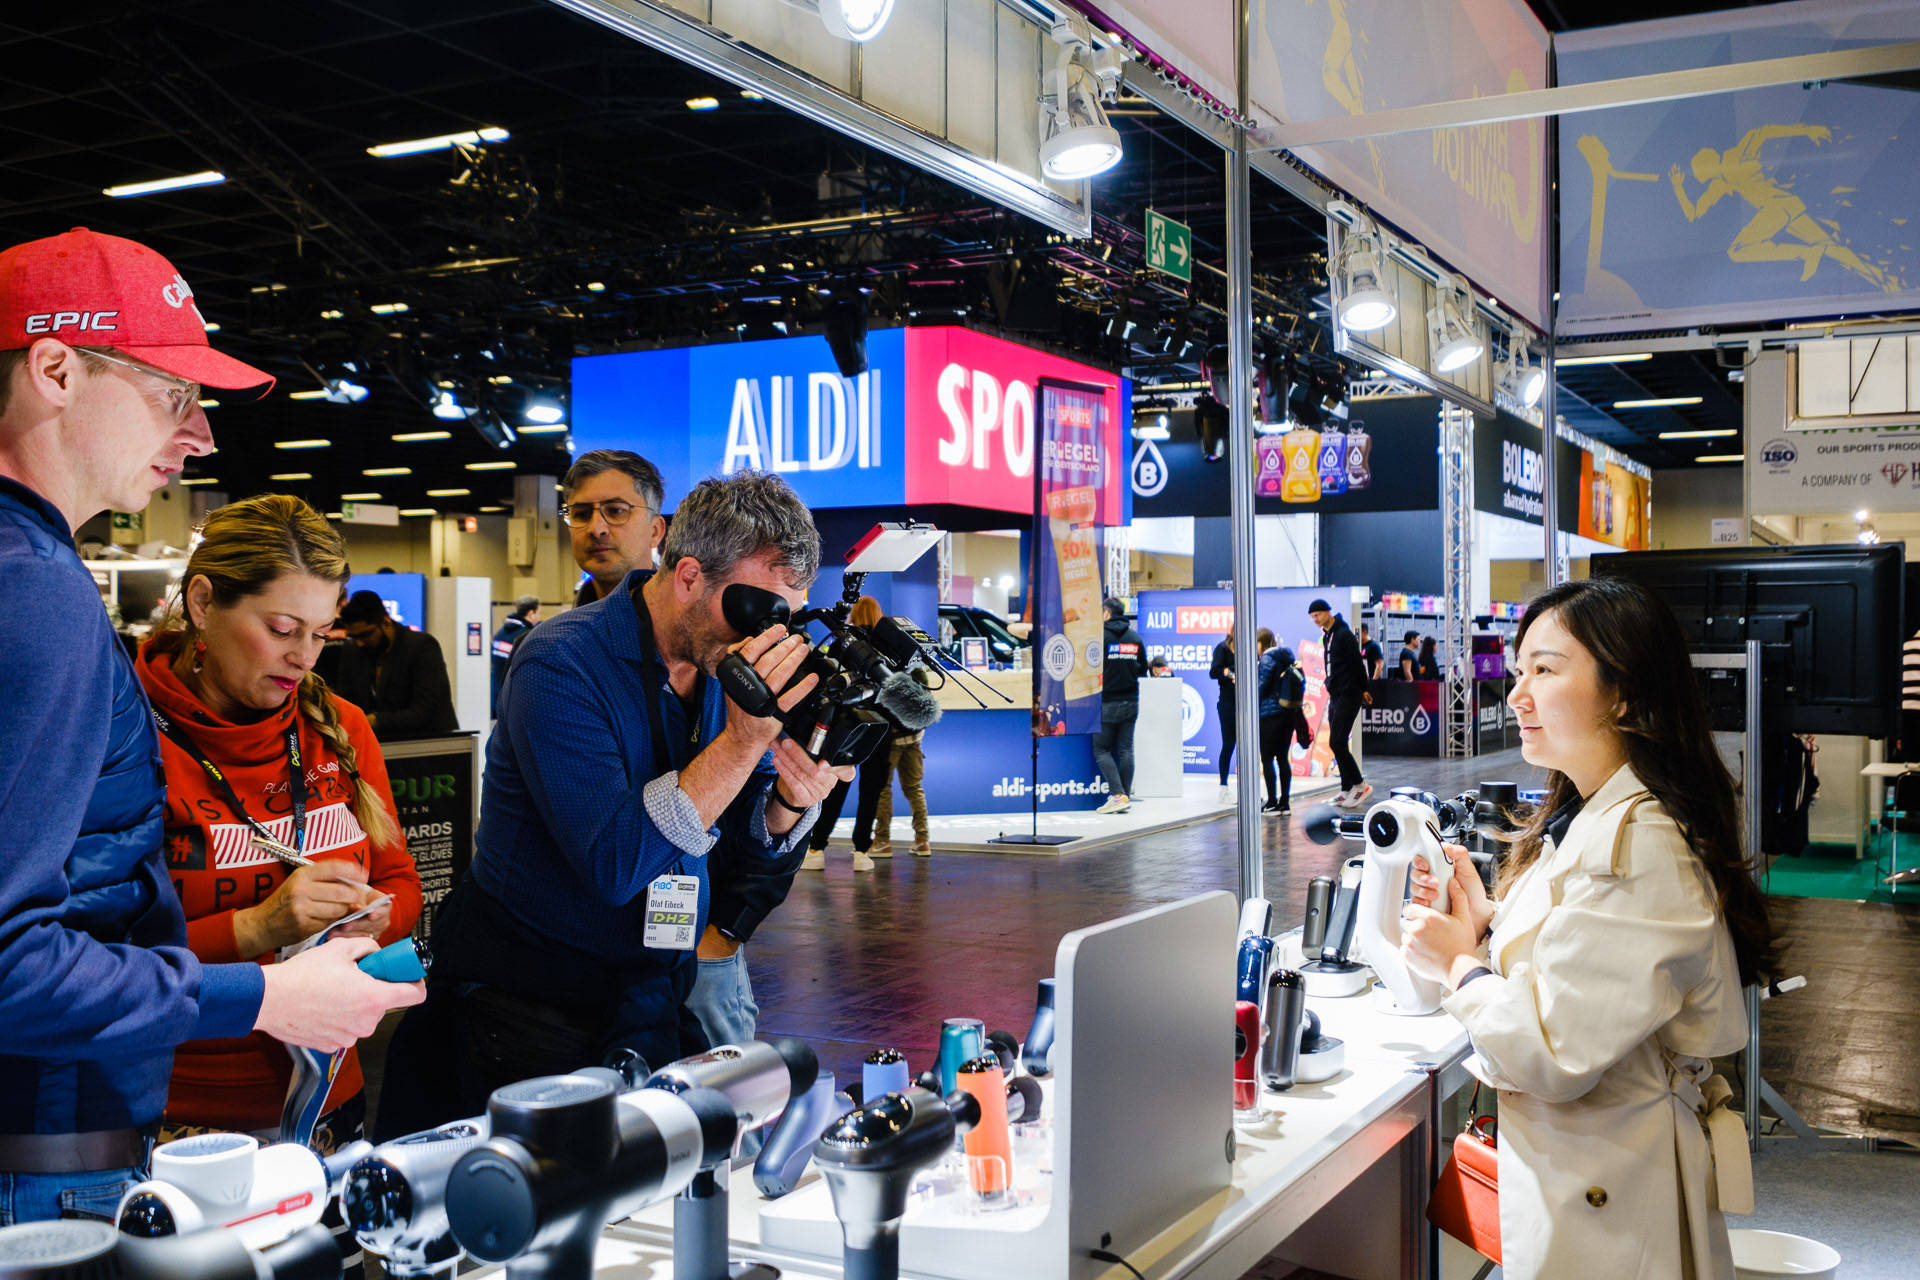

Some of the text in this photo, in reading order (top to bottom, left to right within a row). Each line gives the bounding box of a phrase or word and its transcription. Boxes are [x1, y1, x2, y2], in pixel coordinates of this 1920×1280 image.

[24, 310, 120, 335] EPIC
[722, 369, 882, 474] ALDI
[1764, 450, 1795, 462] ISO
[1817, 445, 1840, 454] OUR
[1843, 444, 1885, 453] SPORTS
[1503, 440, 1544, 494] BOLERO
[1802, 476, 1809, 487] A
[1811, 473, 1858, 488] COMPANY
[1860, 473, 1872, 486] OF
[1146, 612, 1173, 629] ALDI
[732, 667, 755, 691] SONY
[1362, 708, 1405, 724] LERO
[263, 781, 292, 794] PLA
[419, 849, 453, 862] GLOVES
[651, 900, 684, 909] Olaf Eibeck
[653, 912, 690, 924] DHZ
